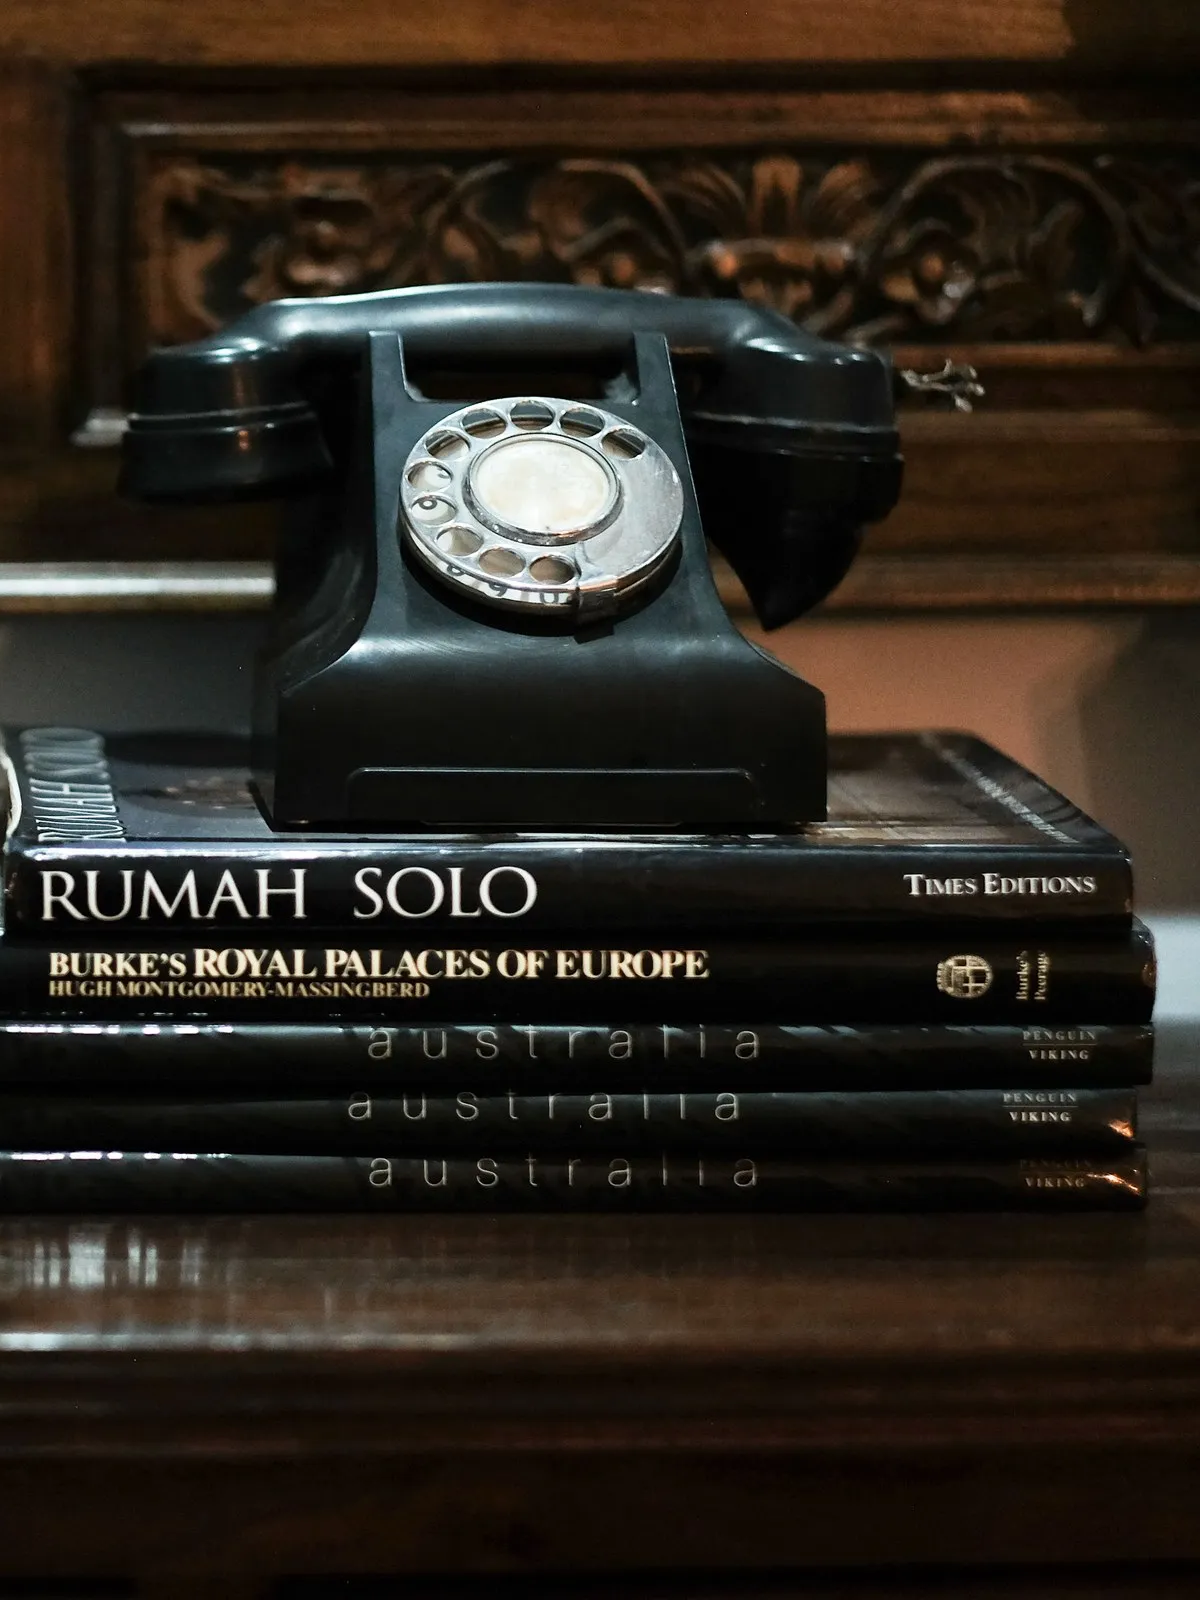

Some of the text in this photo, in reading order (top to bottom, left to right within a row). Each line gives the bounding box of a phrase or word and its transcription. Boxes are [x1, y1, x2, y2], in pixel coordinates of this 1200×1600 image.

[39, 866, 539, 922] RUMAH SOLO
[903, 872, 1097, 896] TIMES EDITIONS
[49, 948, 711, 980] BURKE'S ROYAL PALACES OF EUROPE
[49, 980, 431, 998] HUGH MONTGOMERY-MASSINGBERD
[366, 1023, 761, 1060] australia
[1022, 1030, 1097, 1042] PENGUIN
[1029, 1049, 1090, 1061] VIKING
[347, 1089, 741, 1122] australia
[1003, 1092, 1078, 1104] PENGUIN
[1009, 1111, 1073, 1123] VIKING
[368, 1153, 760, 1188] australia
[1025, 1176, 1086, 1188] VIKING
